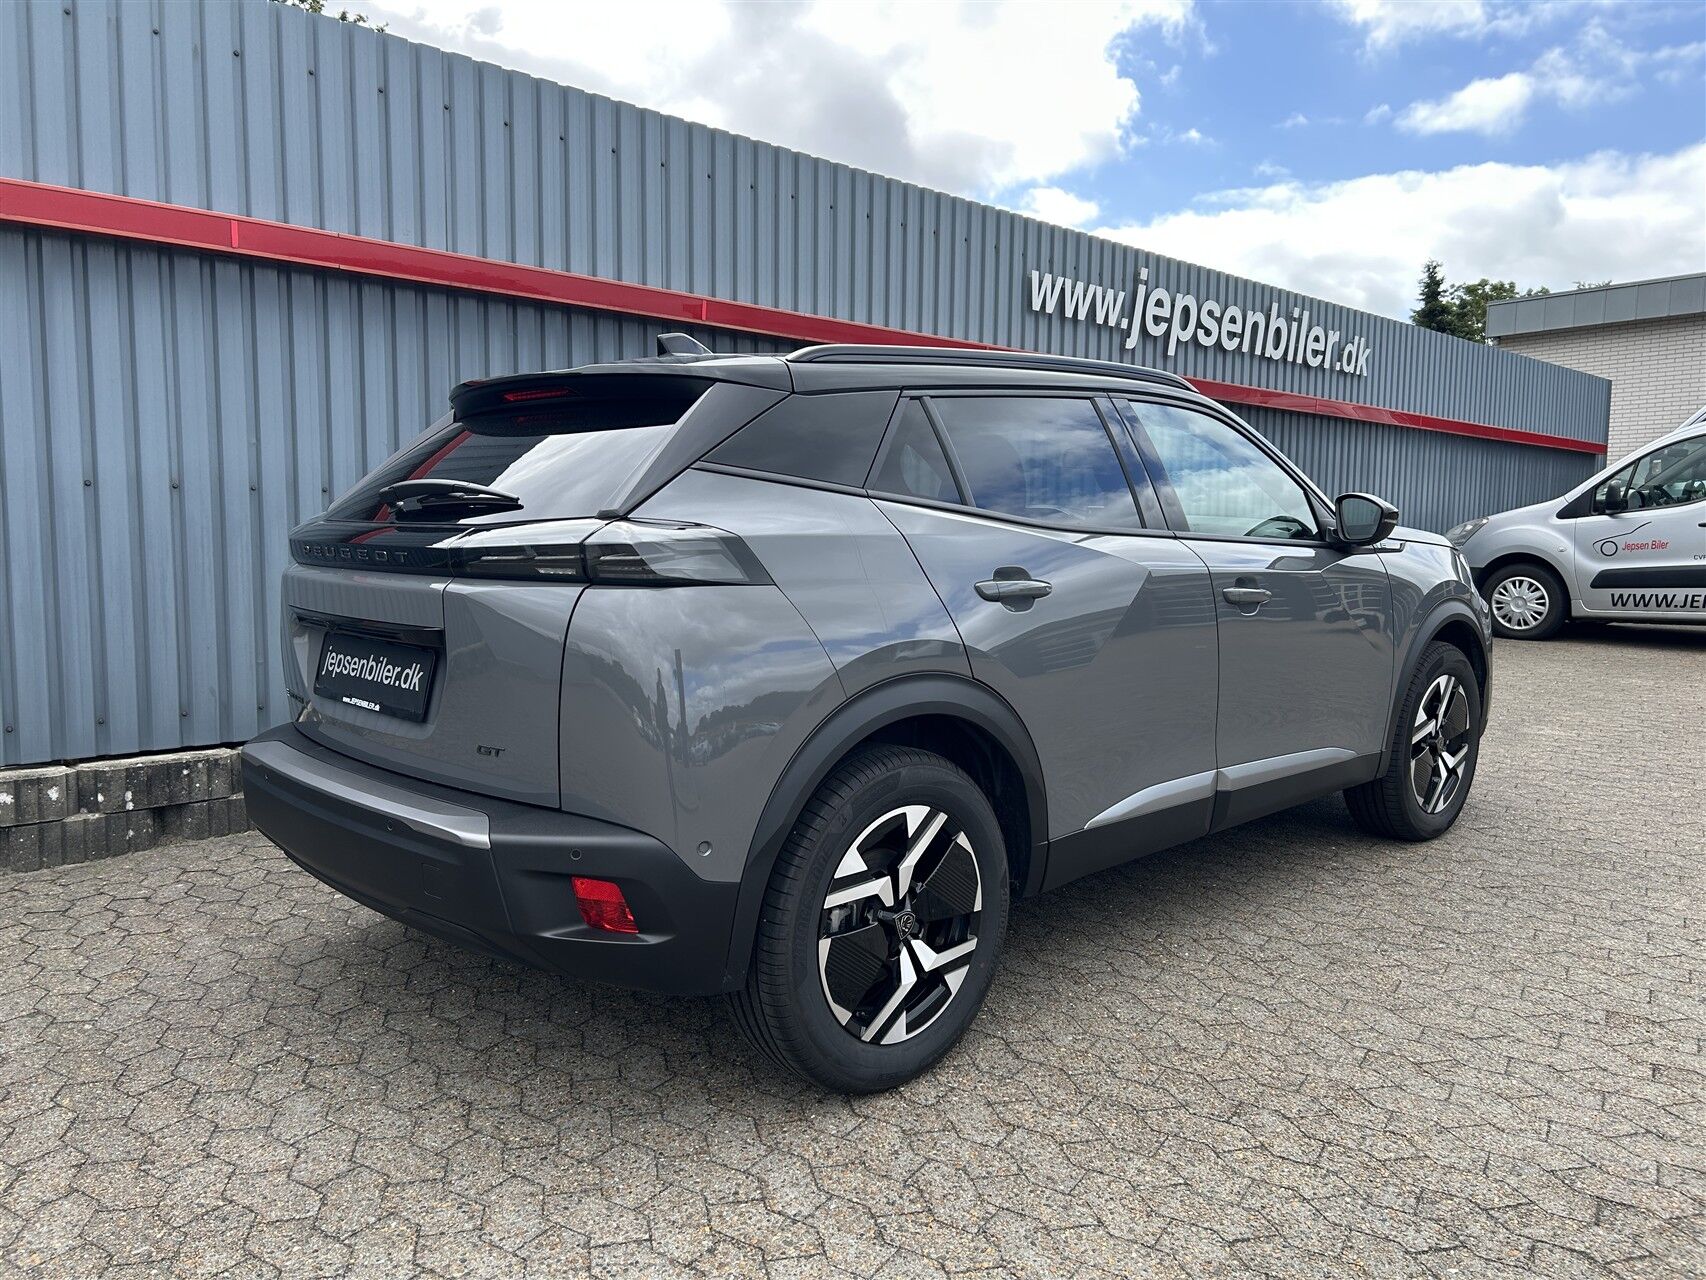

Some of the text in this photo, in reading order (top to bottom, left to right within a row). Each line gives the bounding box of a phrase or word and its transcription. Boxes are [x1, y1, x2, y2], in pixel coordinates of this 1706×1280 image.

[1031, 267, 1371, 377] www.jepsenbiler.dk
[303, 546, 408, 563] PEUGEOT
[1622, 540, 1669, 552] Jepsen Biler
[322, 646, 423, 692] jepsenbiler.dk
[477, 744, 506, 758] GT
